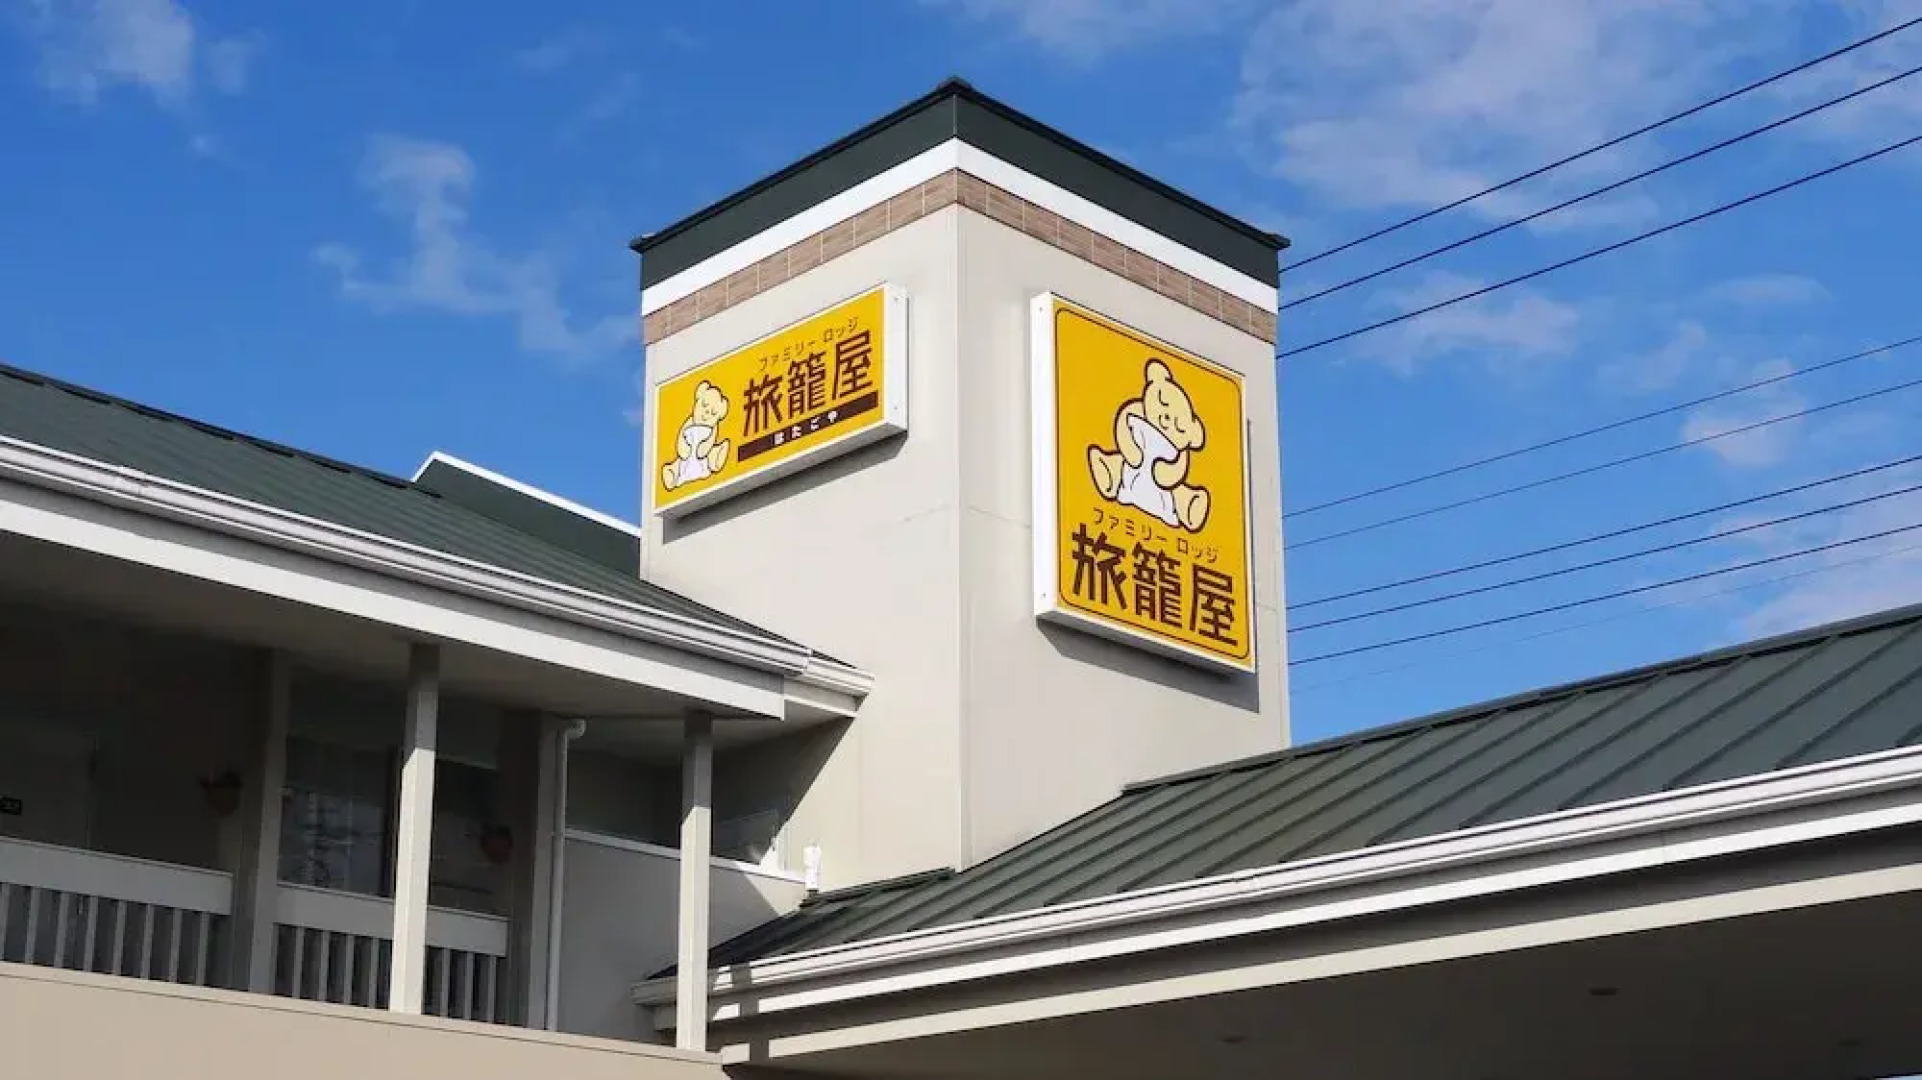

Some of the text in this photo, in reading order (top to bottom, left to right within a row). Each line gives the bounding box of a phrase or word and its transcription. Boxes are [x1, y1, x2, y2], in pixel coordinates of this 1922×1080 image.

[758, 317, 859, 371] ファミリー ロッジ
[743, 330, 873, 437] 旅籠屋
[774, 411, 838, 445] はたごや
[1093, 507, 1219, 563] ファミリー ロッジ
[1072, 522, 1238, 647] 旅籠屋
